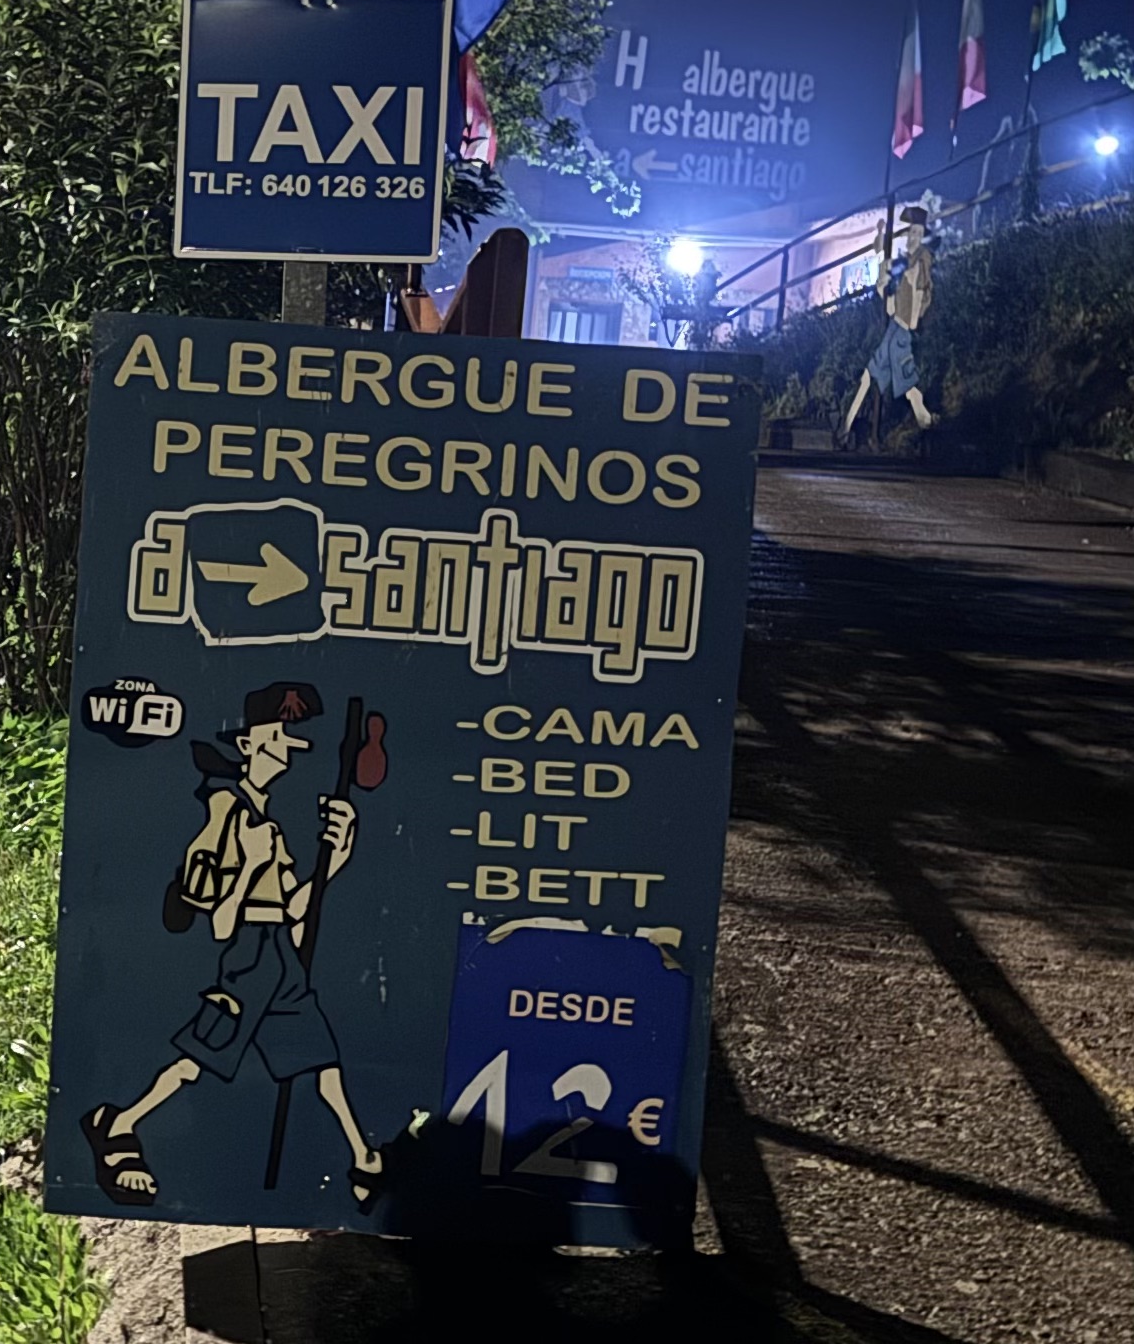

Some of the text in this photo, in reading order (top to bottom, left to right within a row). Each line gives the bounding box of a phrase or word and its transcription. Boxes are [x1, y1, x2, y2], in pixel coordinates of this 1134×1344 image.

[615, 29, 648, 90] H
[682, 49, 815, 113] albergue
[197, 83, 424, 166] TAXI
[629, 99, 811, 146] restaurante
[189, 171, 426, 199] TLF: 640 126 326
[680, 147, 806, 202] santiago
[113, 334, 734, 428] ALBERGUE DE
[153, 420, 702, 509] PEREGRINOS
[325, 518, 695, 670] santiago
[114, 679, 156, 693] ZONA
[456, 705, 699, 749] -CAMA
[452, 757, 630, 798] -BED
[450, 811, 588, 851] -LIT
[446, 865, 665, 908] -BETT
[509, 989, 635, 1026] DESDE
